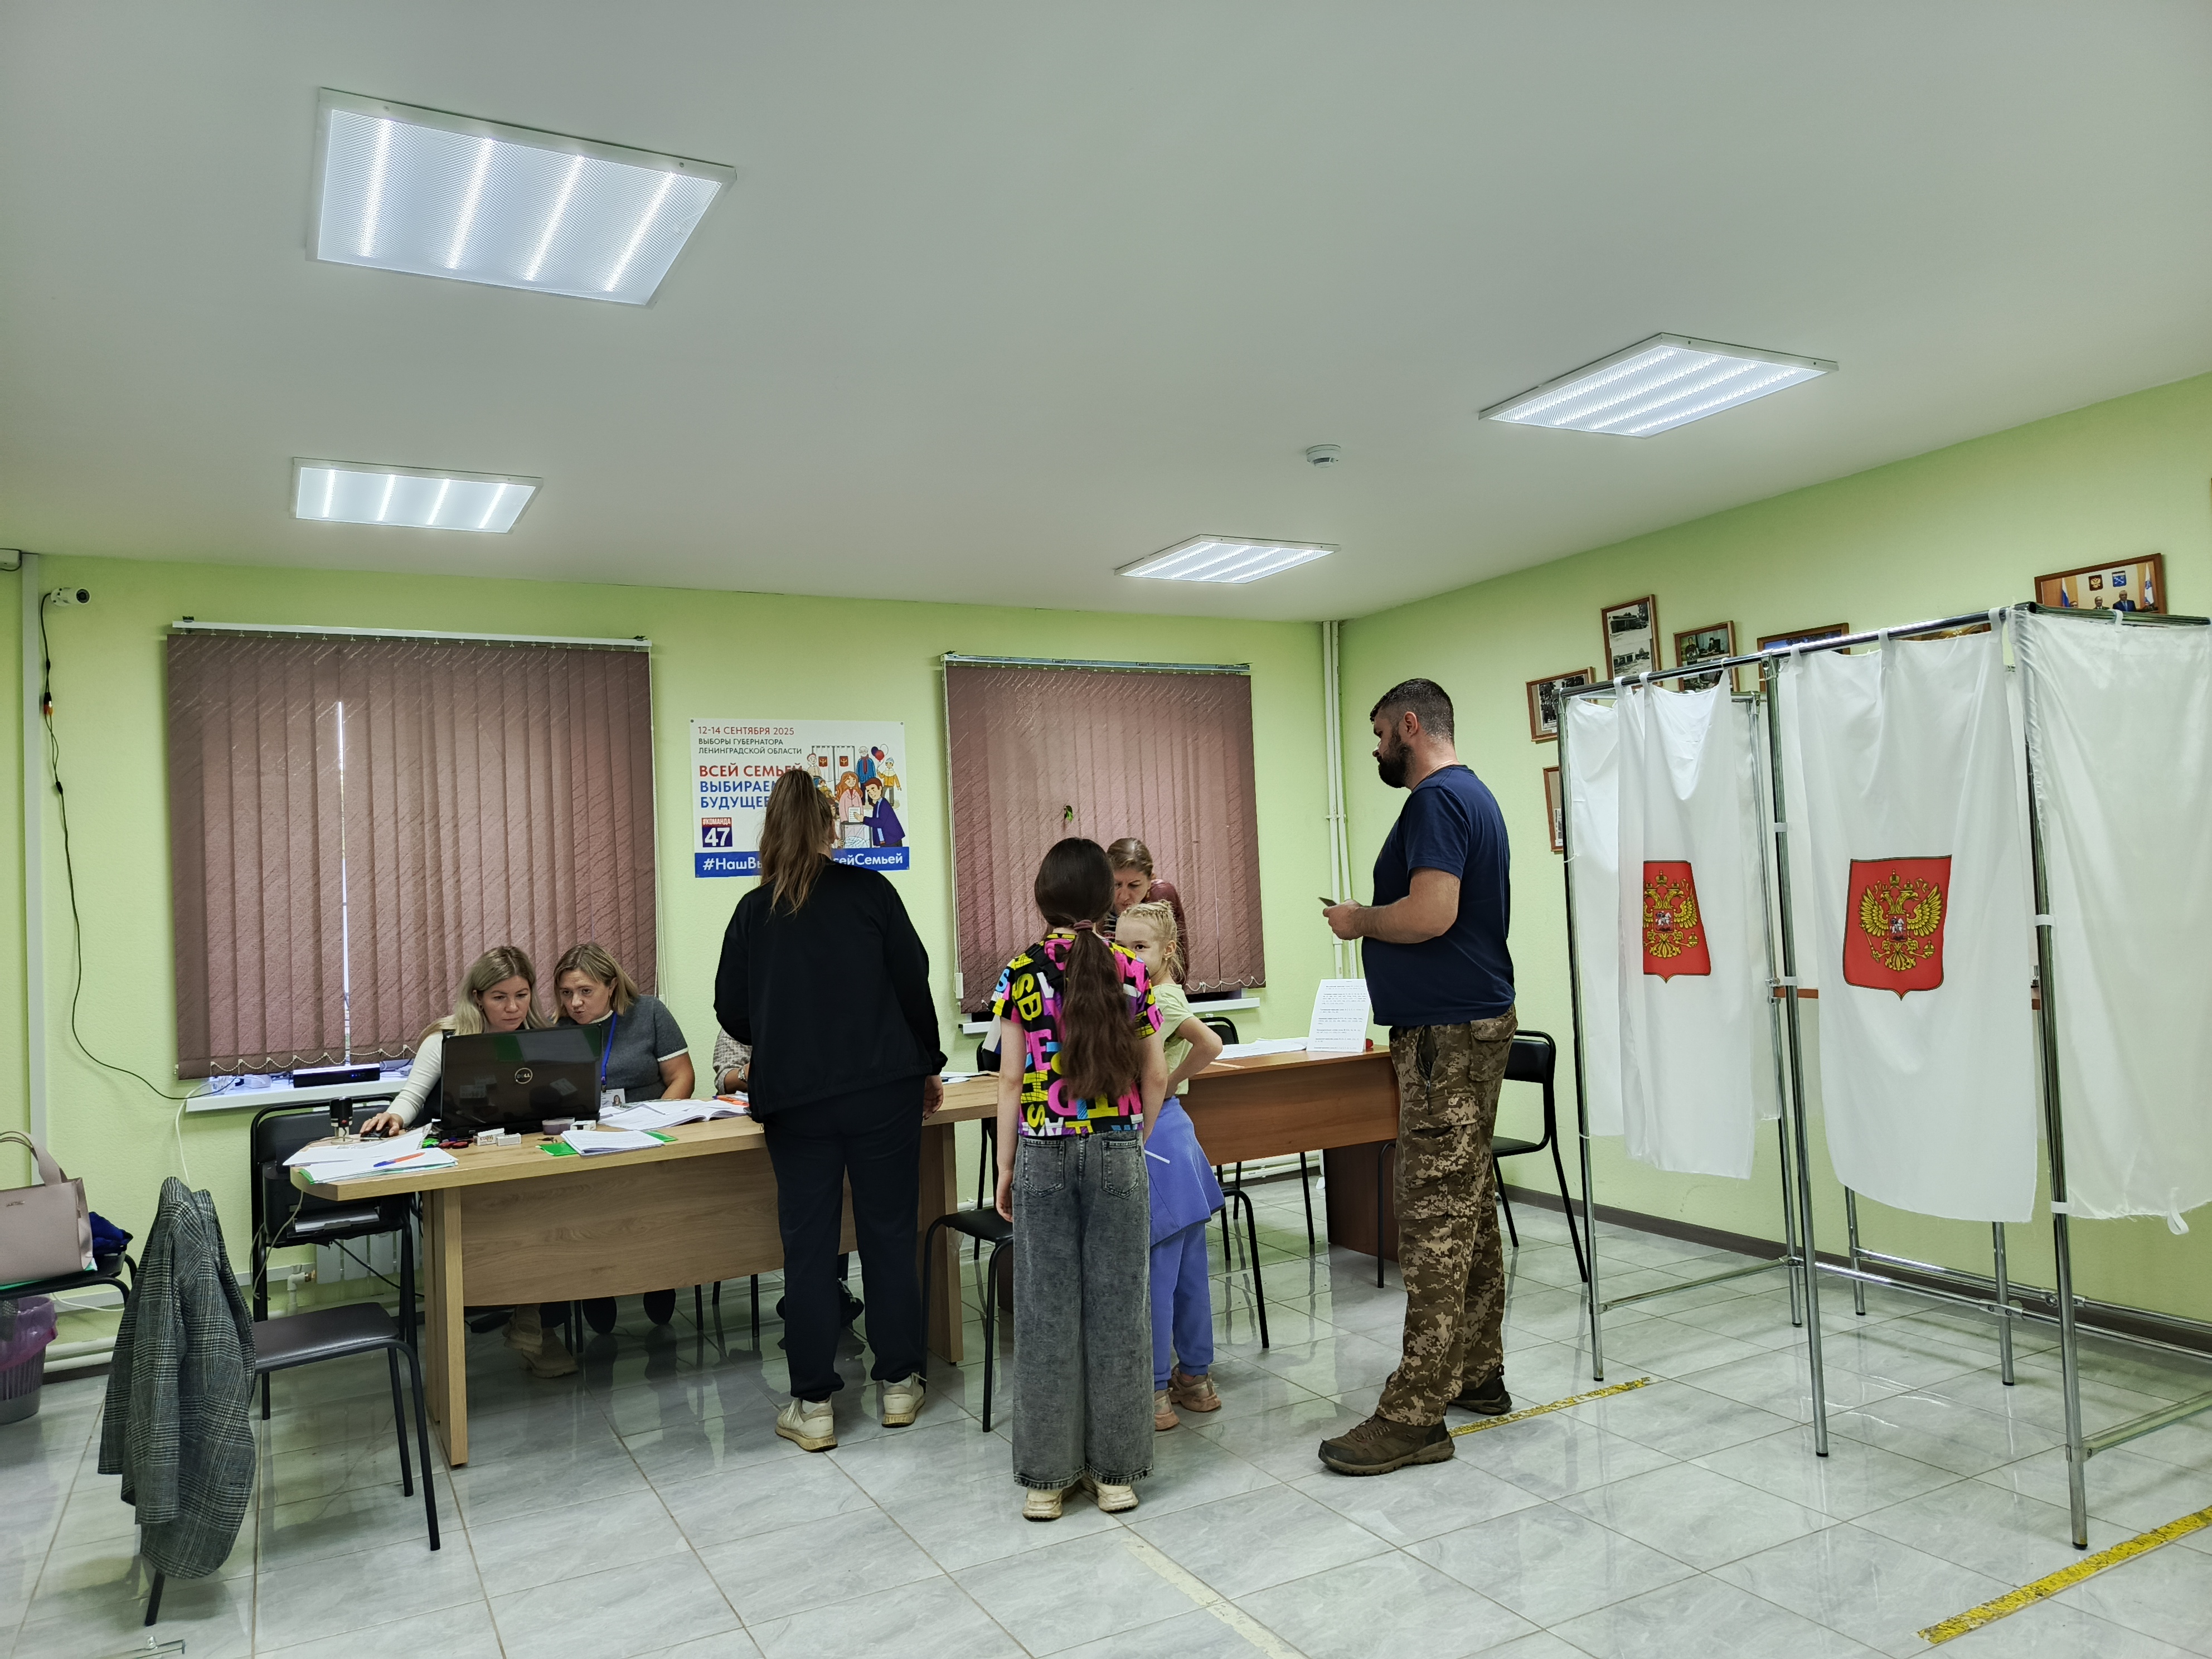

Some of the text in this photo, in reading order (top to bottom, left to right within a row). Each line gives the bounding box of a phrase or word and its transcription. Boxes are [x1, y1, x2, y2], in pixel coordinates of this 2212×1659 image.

[724, 726, 770, 735] СЕНТЯБРЯ
[773, 727, 794, 735] 2025
[698, 746, 765, 755] ЛЕНИНГРАДСКОЙ
[700, 763, 739, 777] ВСЕЙ
[705, 827, 730, 847] 47
